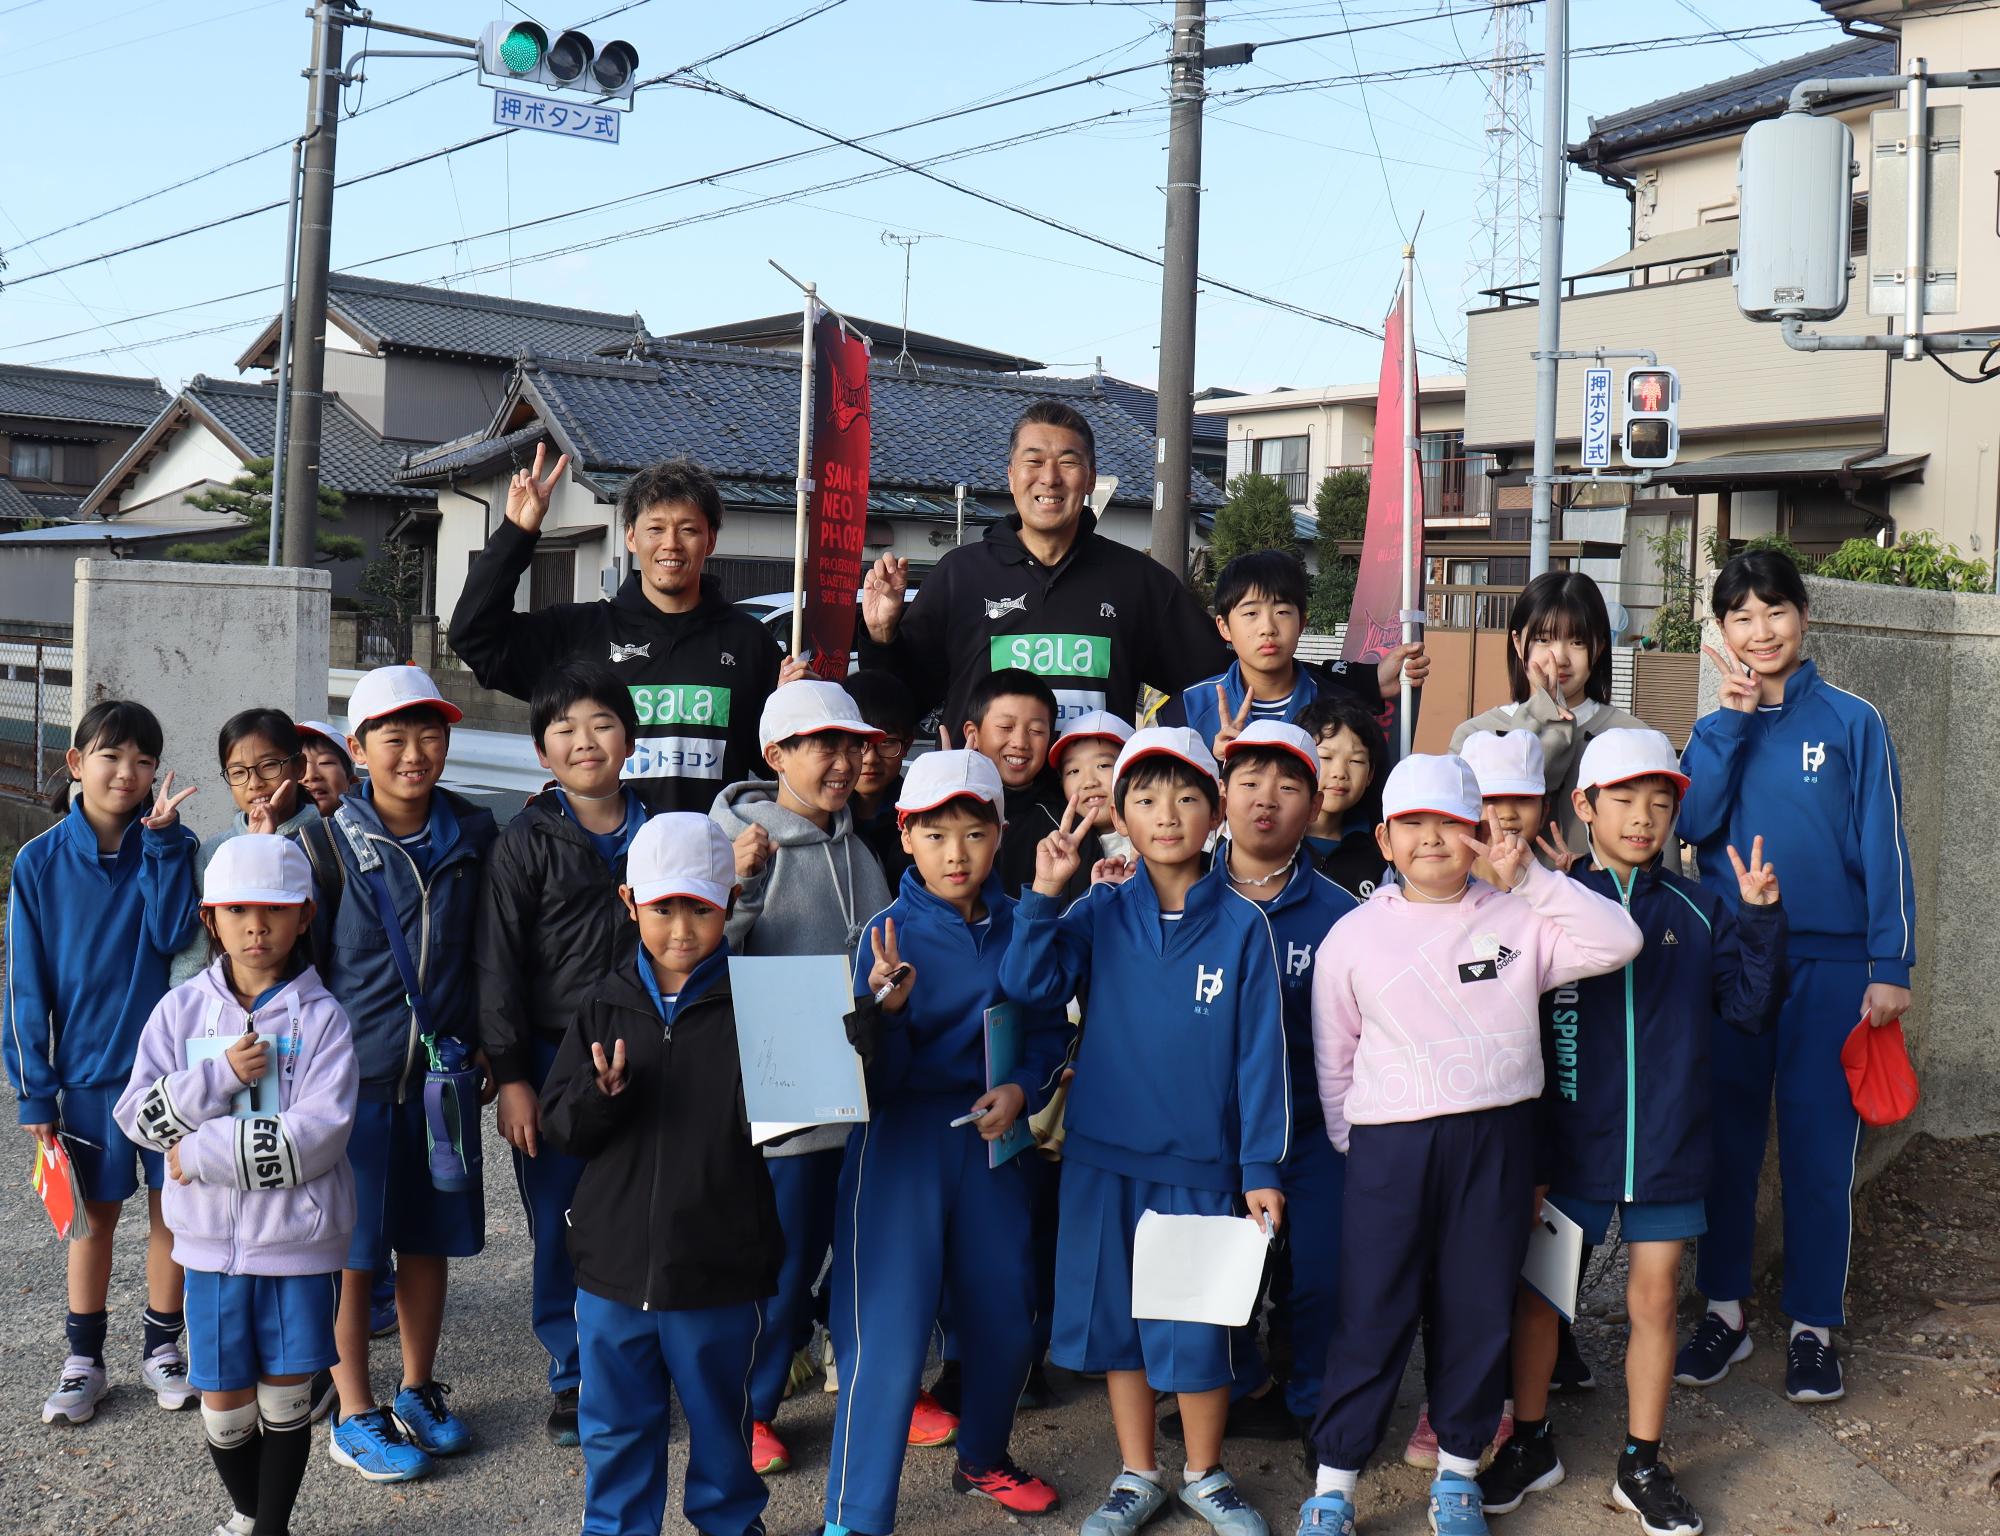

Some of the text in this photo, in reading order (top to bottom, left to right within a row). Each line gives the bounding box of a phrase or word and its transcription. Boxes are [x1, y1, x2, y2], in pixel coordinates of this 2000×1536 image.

[501, 96, 613, 137] 押ボタン式
[1588, 376, 1606, 460] 押ボタン式
[824, 461, 868, 495] SAN-E
[822, 491, 854, 521] NEO
[820, 522, 864, 553] PHOEN
[1011, 637, 1093, 673] sala
[634, 688, 713, 721] sala
[1056, 704, 1094, 720] ヨコ
[657, 750, 718, 768] トヨコン
[1496, 949, 1522, 970] adidas
[285, 1018, 299, 1067] CHERISH GIRL
[1552, 1009, 1579, 1102] SPORTIF
[1347, 1036, 1532, 1116] adida
